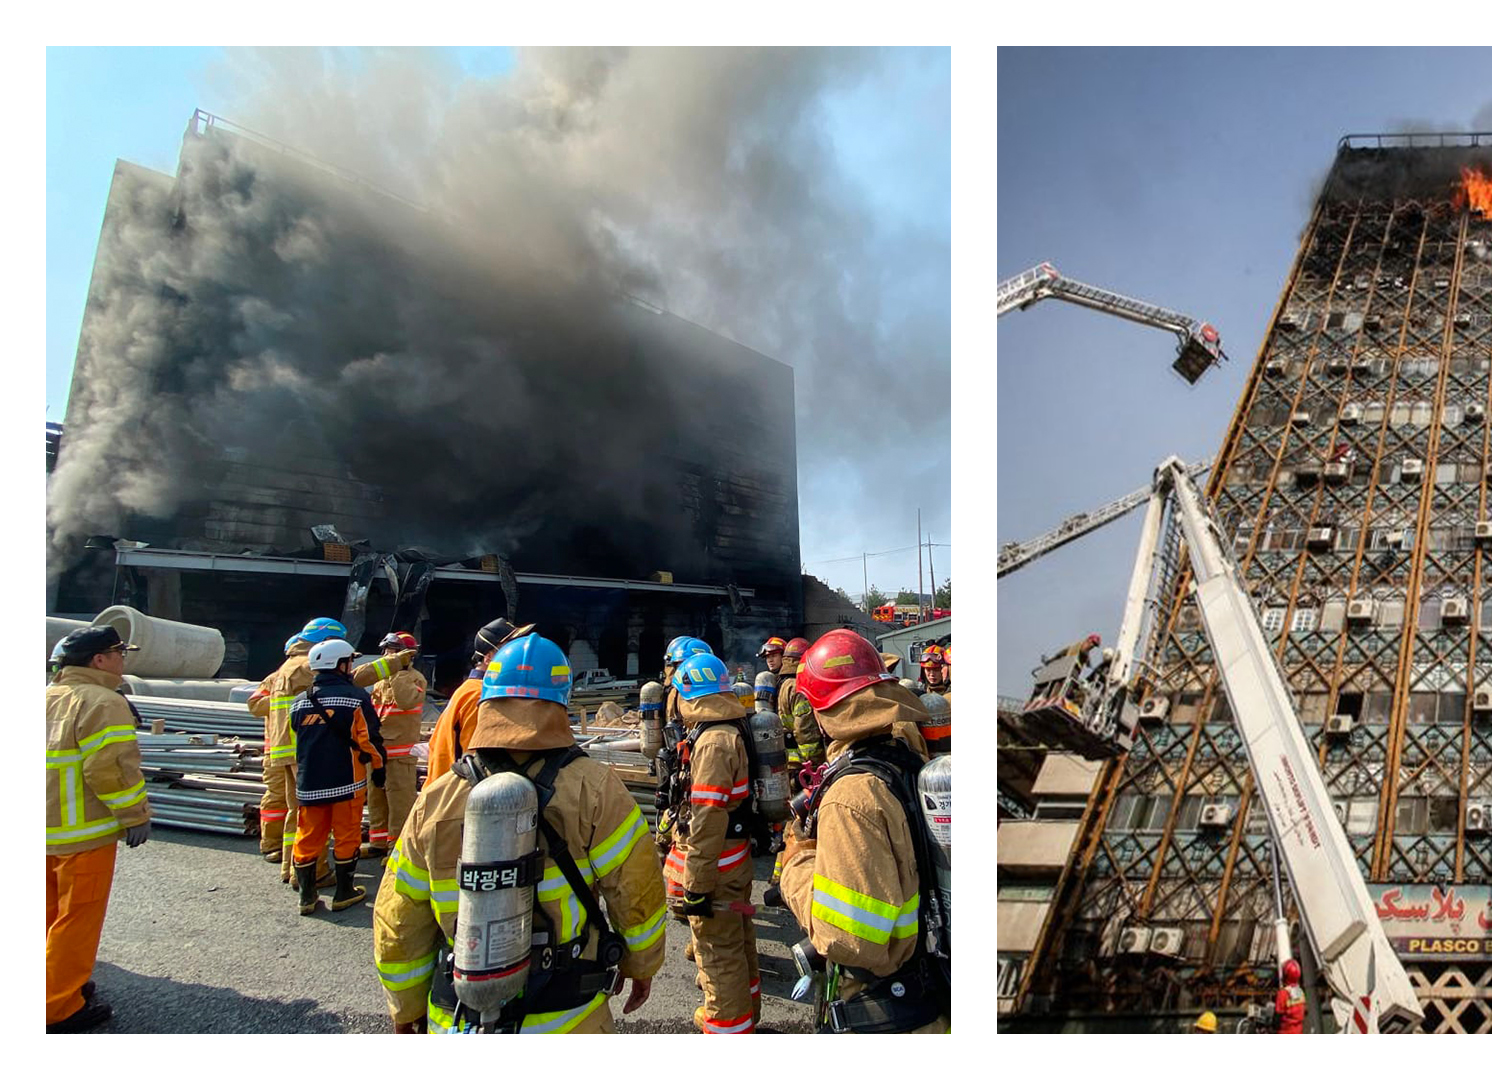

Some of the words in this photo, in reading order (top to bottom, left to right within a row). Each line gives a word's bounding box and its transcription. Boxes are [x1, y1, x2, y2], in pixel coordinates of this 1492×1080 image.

[463, 867, 518, 892] 박광덕
[1374, 887, 1465, 935] پلاسک
[1409, 940, 1479, 952] PLASCO
